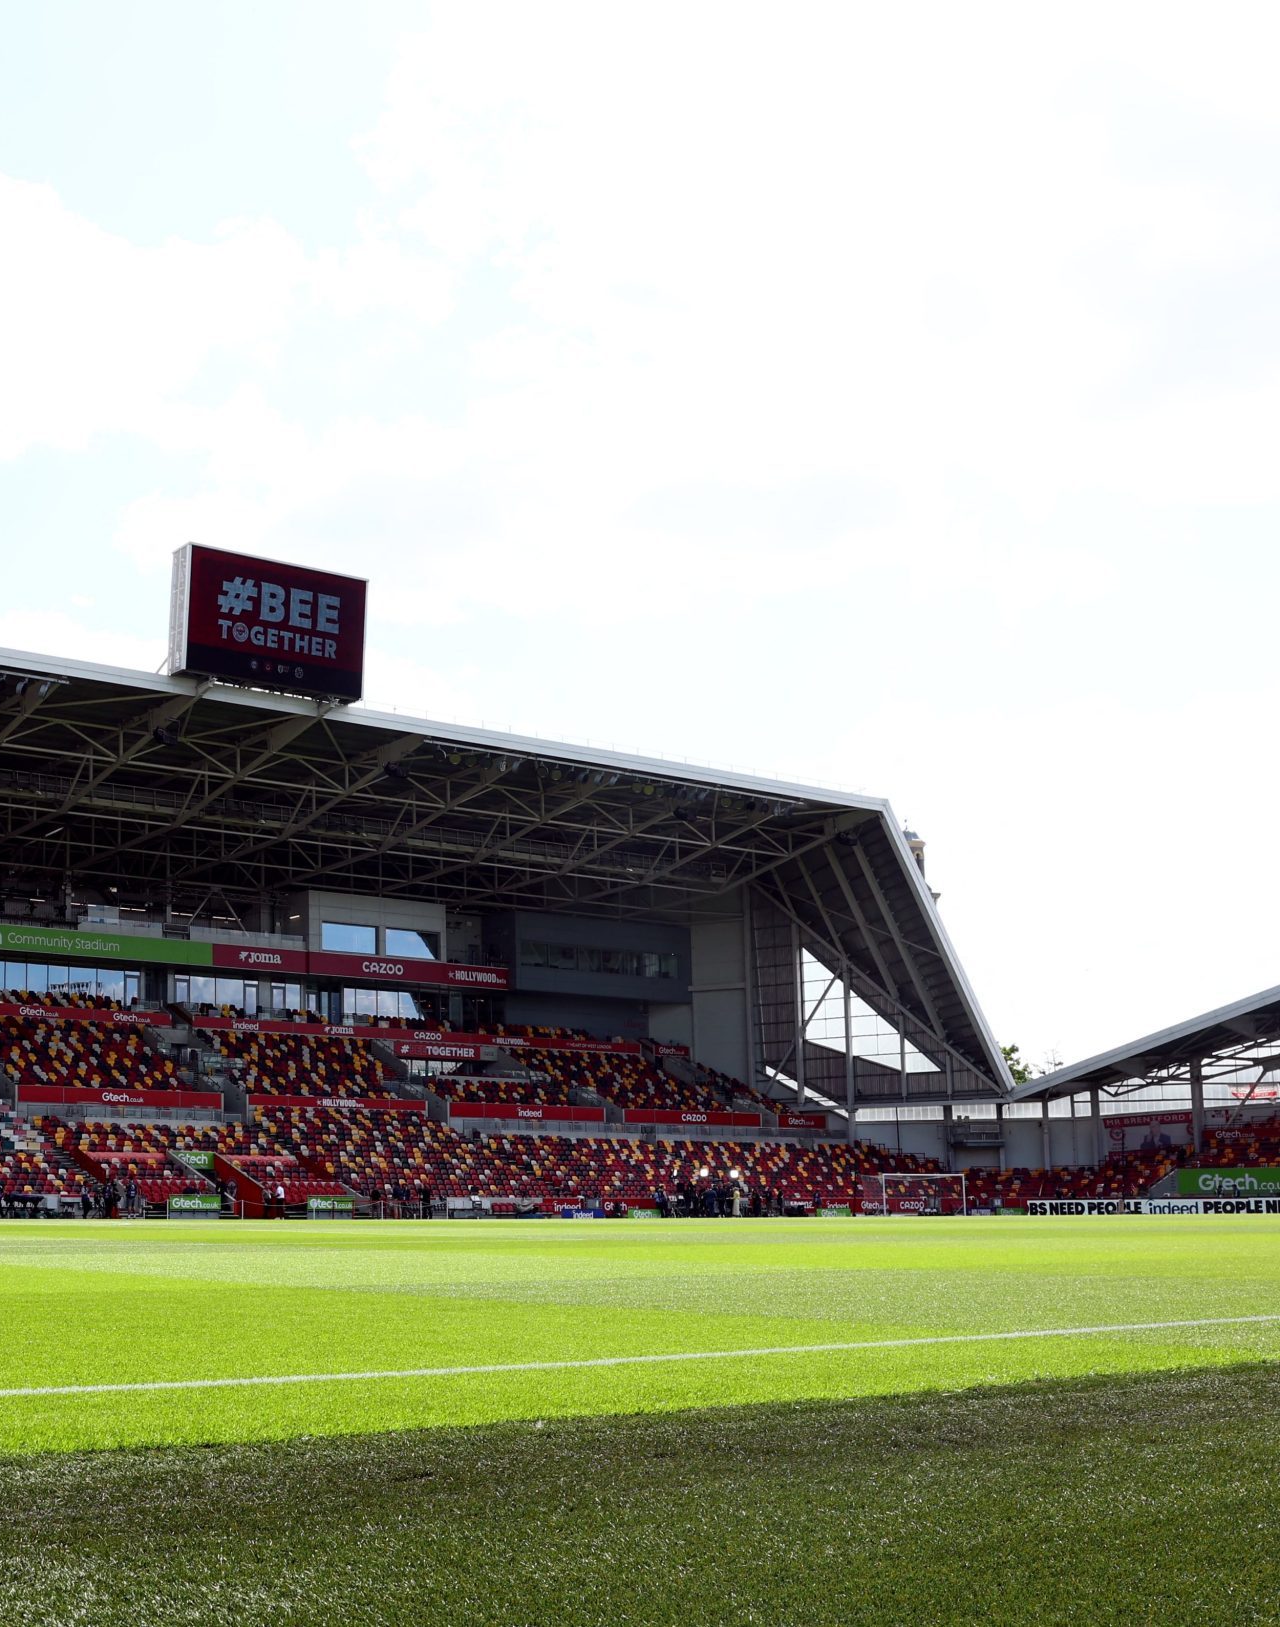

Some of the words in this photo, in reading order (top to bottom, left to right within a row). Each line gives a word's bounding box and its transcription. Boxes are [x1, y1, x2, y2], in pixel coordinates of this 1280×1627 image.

[218, 577, 340, 634] #BEE
[218, 619, 336, 659] TOGETHER
[8, 932, 73, 950] Community
[75, 938, 120, 952] Stadium
[20, 1006, 58, 1018] Gtech.co.uk
[113, 1012, 150, 1023] Gtech.co.uk
[232, 1020, 259, 1031] indeed
[102, 1092, 144, 1103] Gtech.co.uk
[518, 1107, 542, 1118] indeed
[1106, 1118, 1120, 1126] MR
[1124, 1114, 1186, 1125] BRENTFORD
[172, 1198, 219, 1209] Gtech.co.uk
[1050, 1202, 1085, 1215] NEED
[1144, 1200, 1199, 1214] indeed
[1203, 1201, 1264, 1214] PEOPLE
